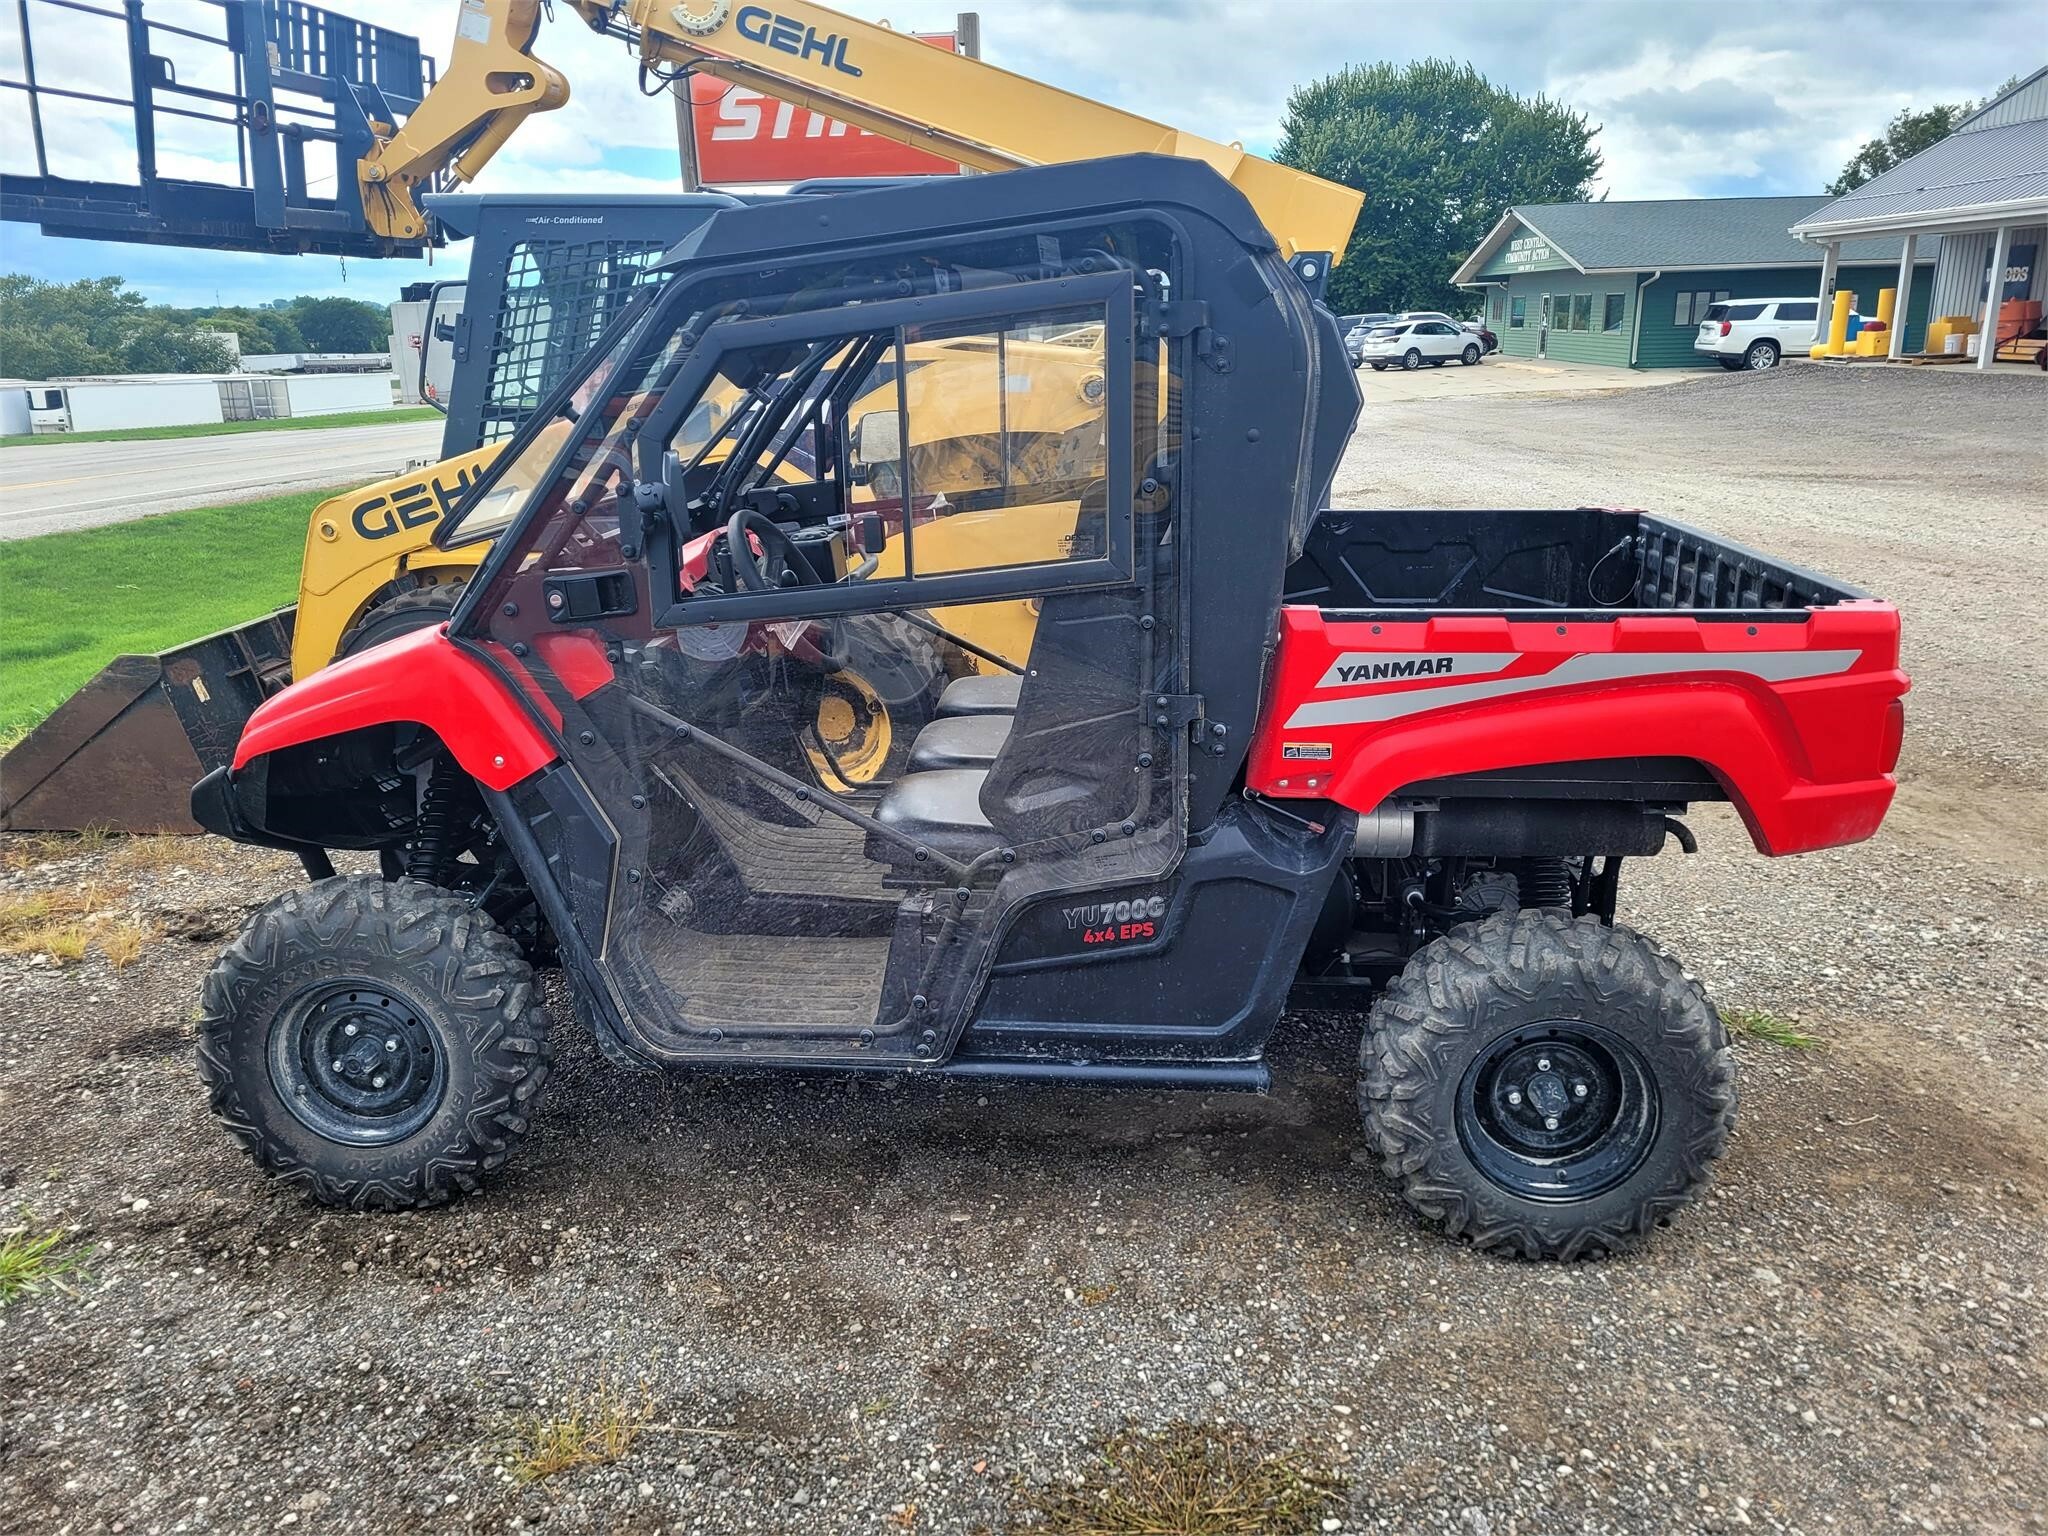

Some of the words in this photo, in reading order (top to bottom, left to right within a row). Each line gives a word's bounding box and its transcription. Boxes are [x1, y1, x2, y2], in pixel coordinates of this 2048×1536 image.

[736, 5, 862, 77] GEHL
[538, 215, 603, 225] Air-Conditioned
[1505, 250, 1531, 264] COMMUNITY
[1532, 247, 1550, 261] ACTION
[352, 464, 483, 540] GEH
[1337, 657, 1453, 682] YANMAR
[1062, 896, 1165, 929] YU700G
[1084, 926, 1116, 943] 4x4
[1120, 922, 1154, 940] EPS
